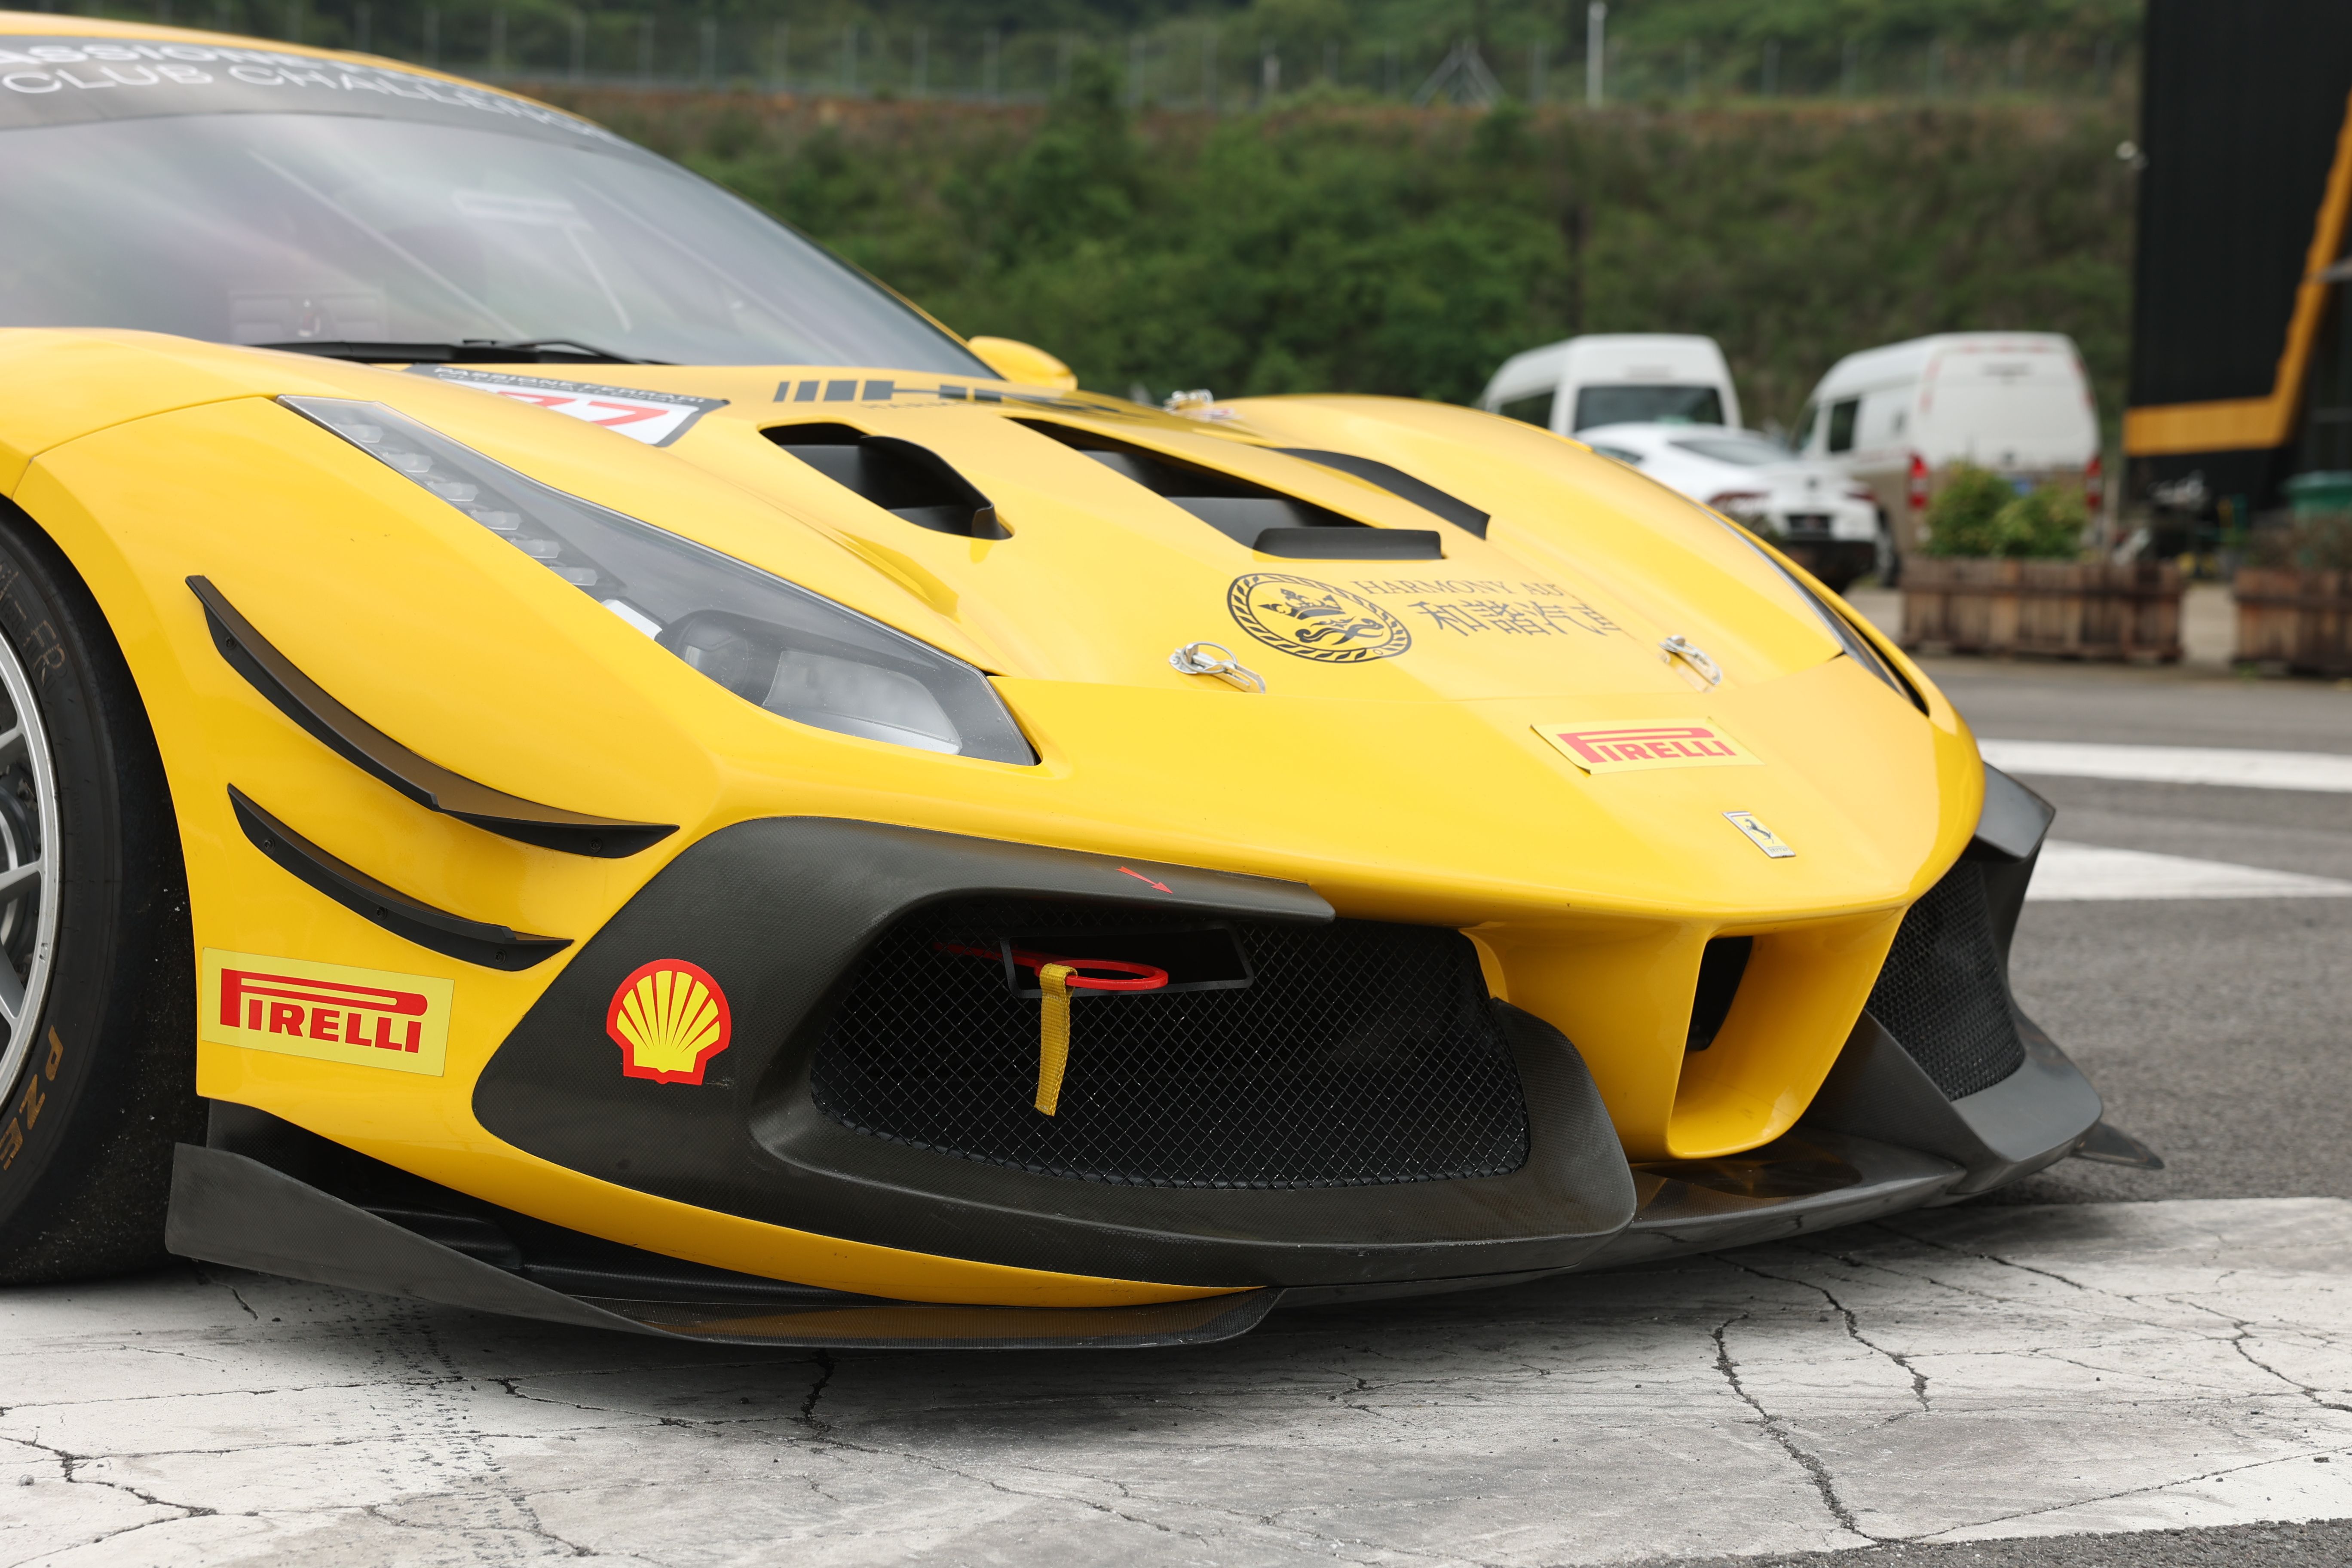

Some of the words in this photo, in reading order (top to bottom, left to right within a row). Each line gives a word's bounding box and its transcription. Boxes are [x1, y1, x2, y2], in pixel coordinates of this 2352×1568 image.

[2, 64, 214, 93] CLUB
[1350, 580, 1517, 595] HARMONY
[1556, 728, 1736, 763] PIRELLI
[220, 968, 428, 1053] PIRELLI
